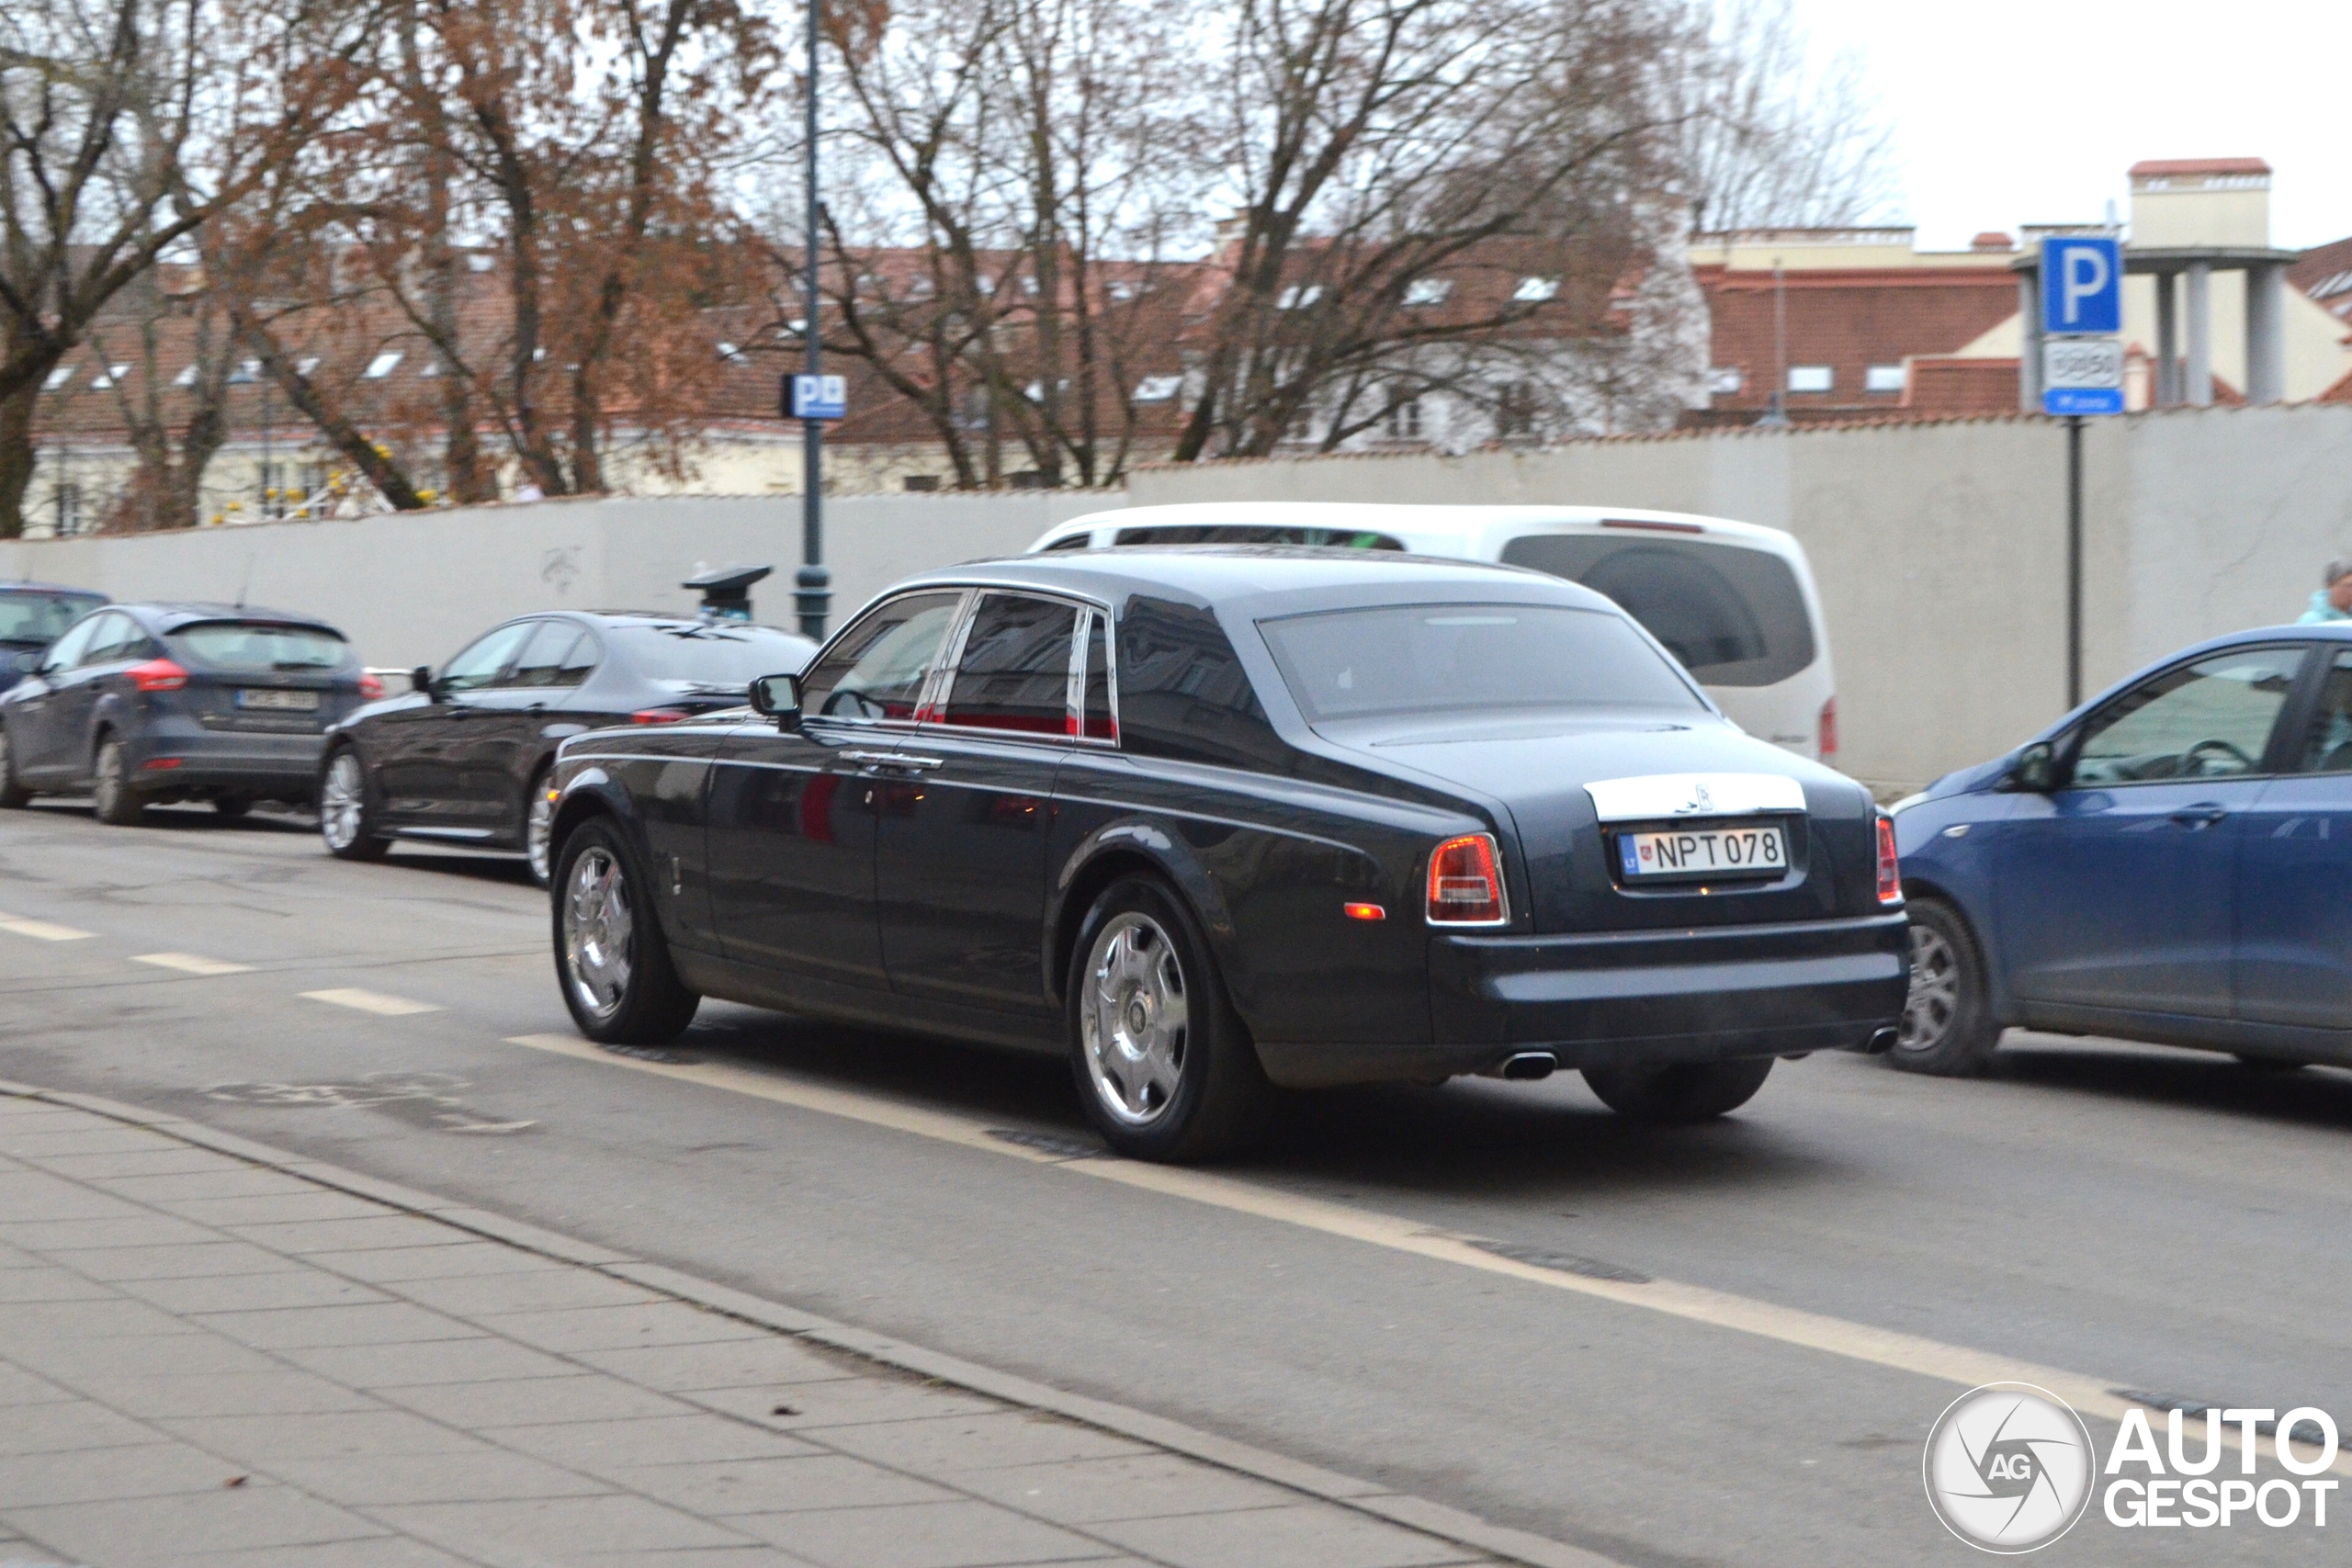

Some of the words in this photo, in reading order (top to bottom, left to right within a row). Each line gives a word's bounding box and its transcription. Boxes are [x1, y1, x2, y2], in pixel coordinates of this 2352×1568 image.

[2064, 247, 2109, 323] P
[795, 376, 819, 415] P
[1624, 857, 1636, 869] LT
